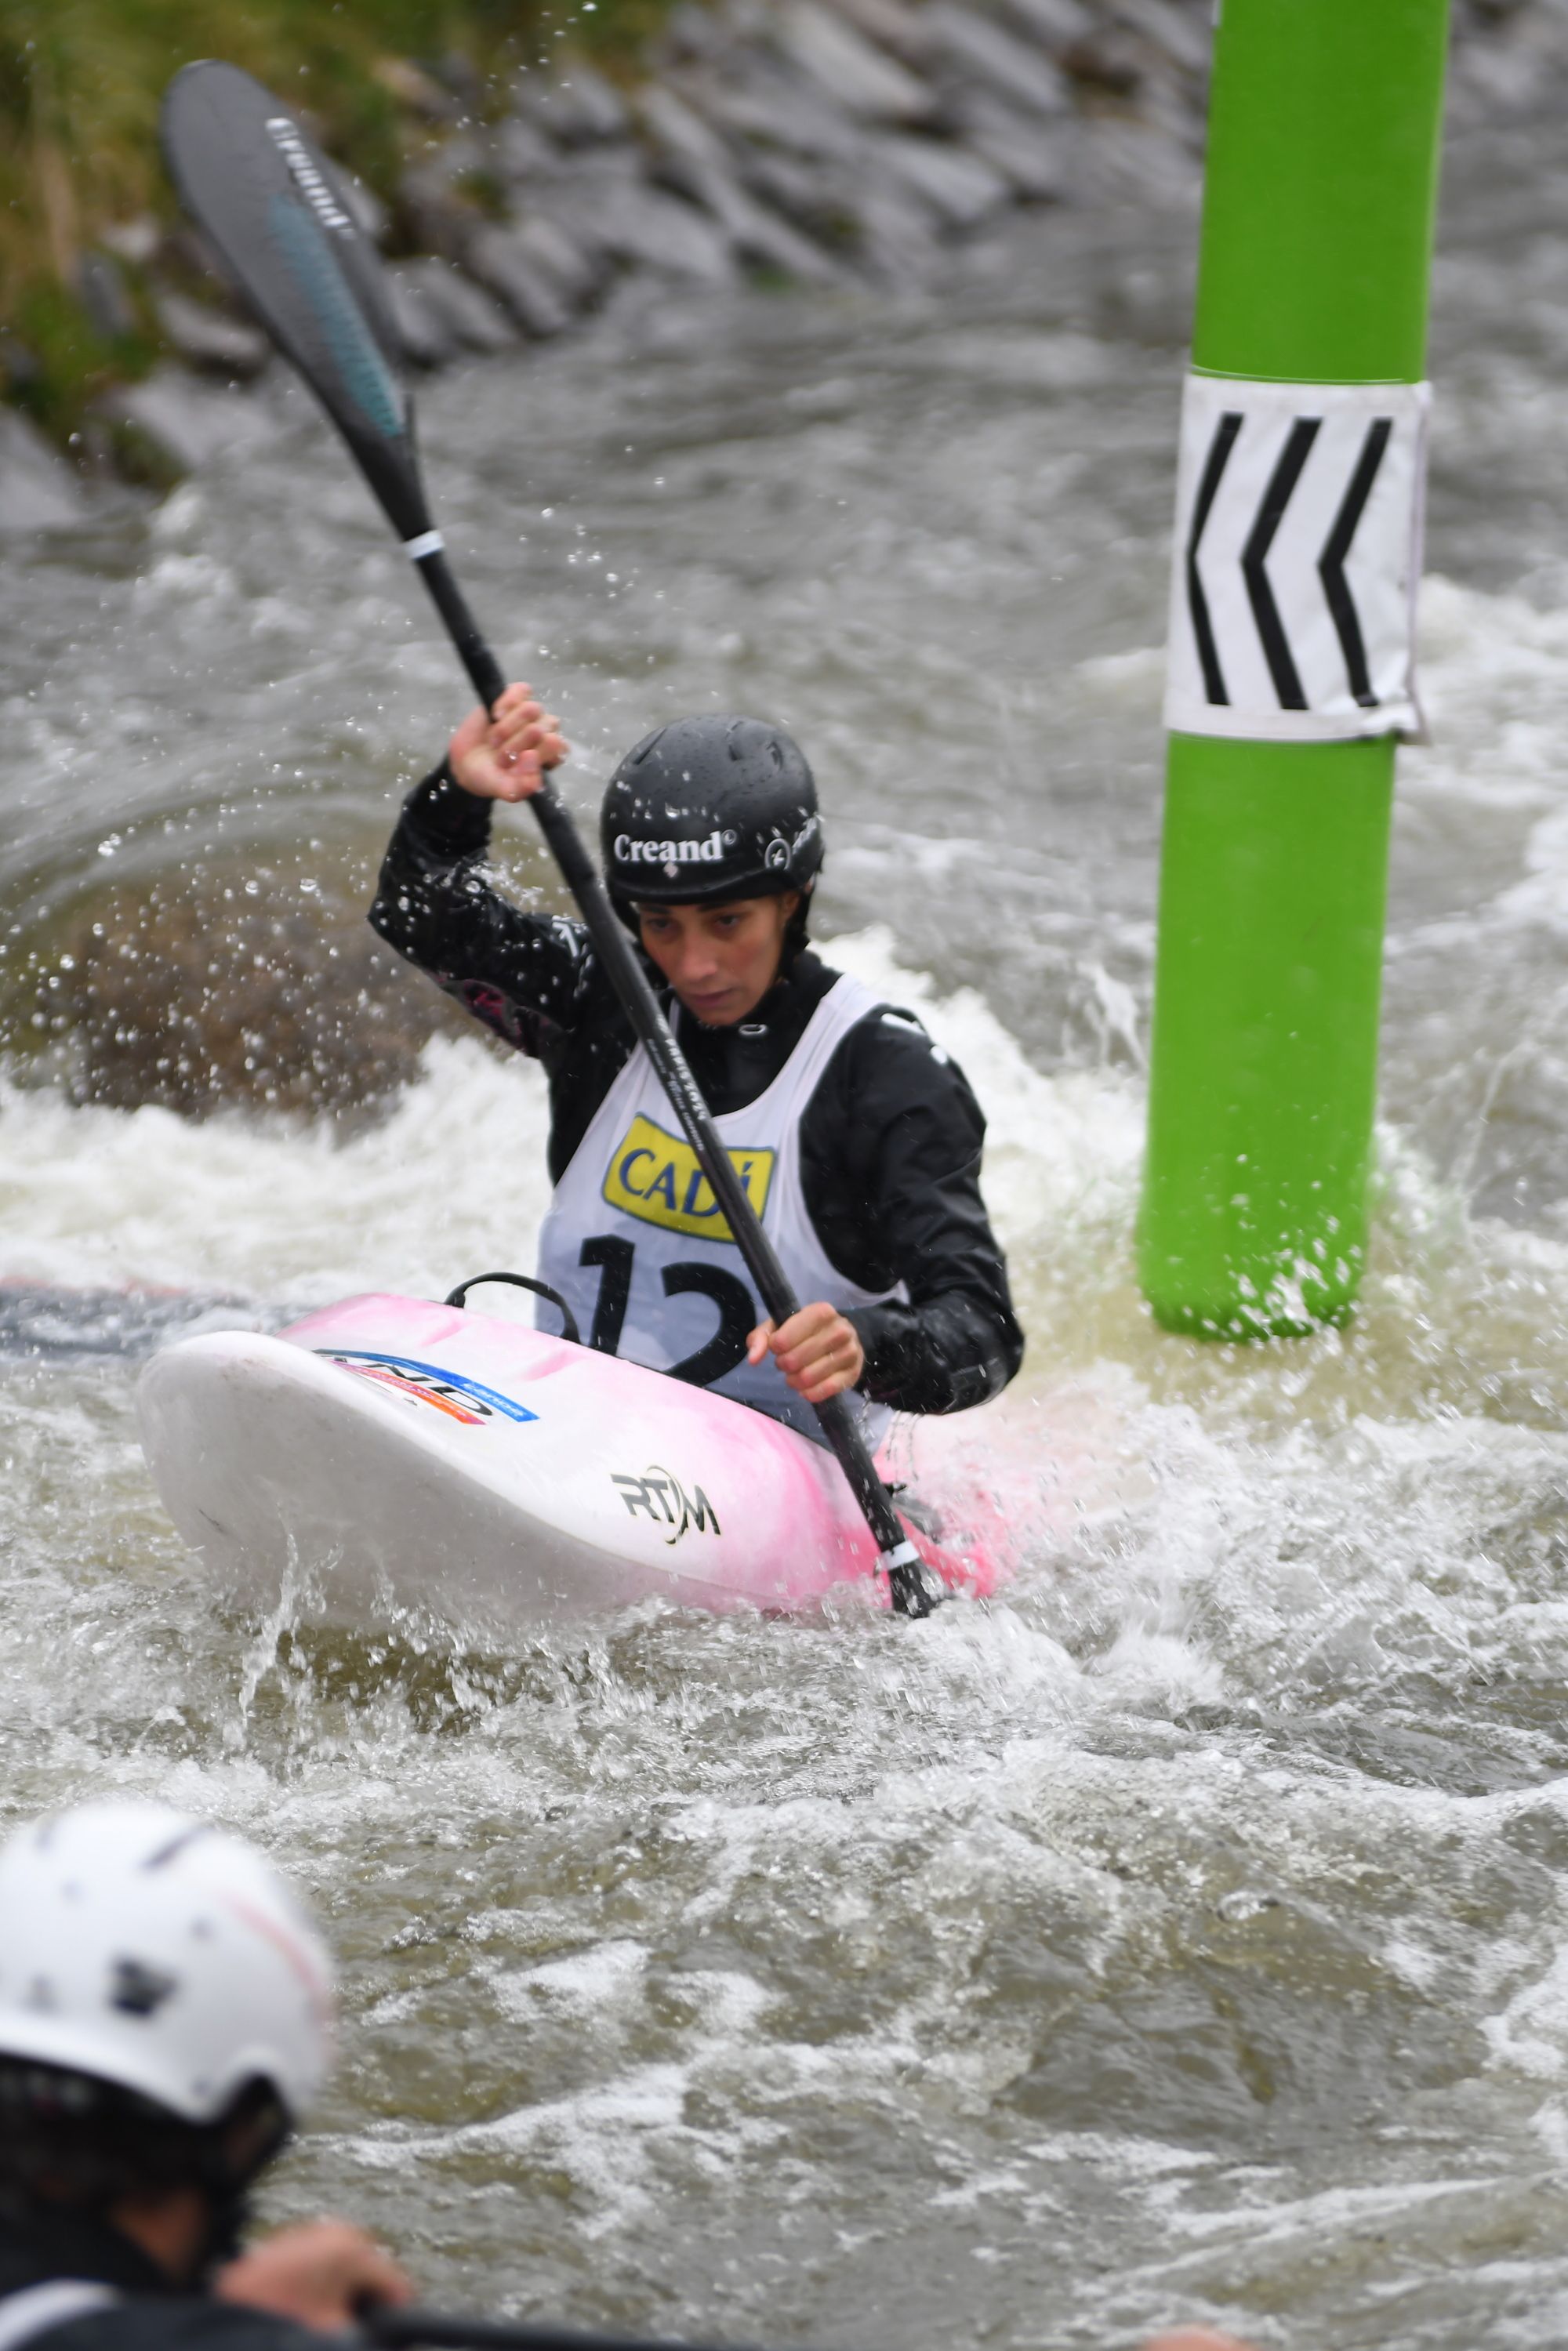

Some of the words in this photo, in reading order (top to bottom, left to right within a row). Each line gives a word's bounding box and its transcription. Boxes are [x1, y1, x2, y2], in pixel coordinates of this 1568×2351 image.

[614, 831, 724, 862] Creand
[579, 1234, 757, 1388] 12
[610, 1472, 721, 1536] RTM
